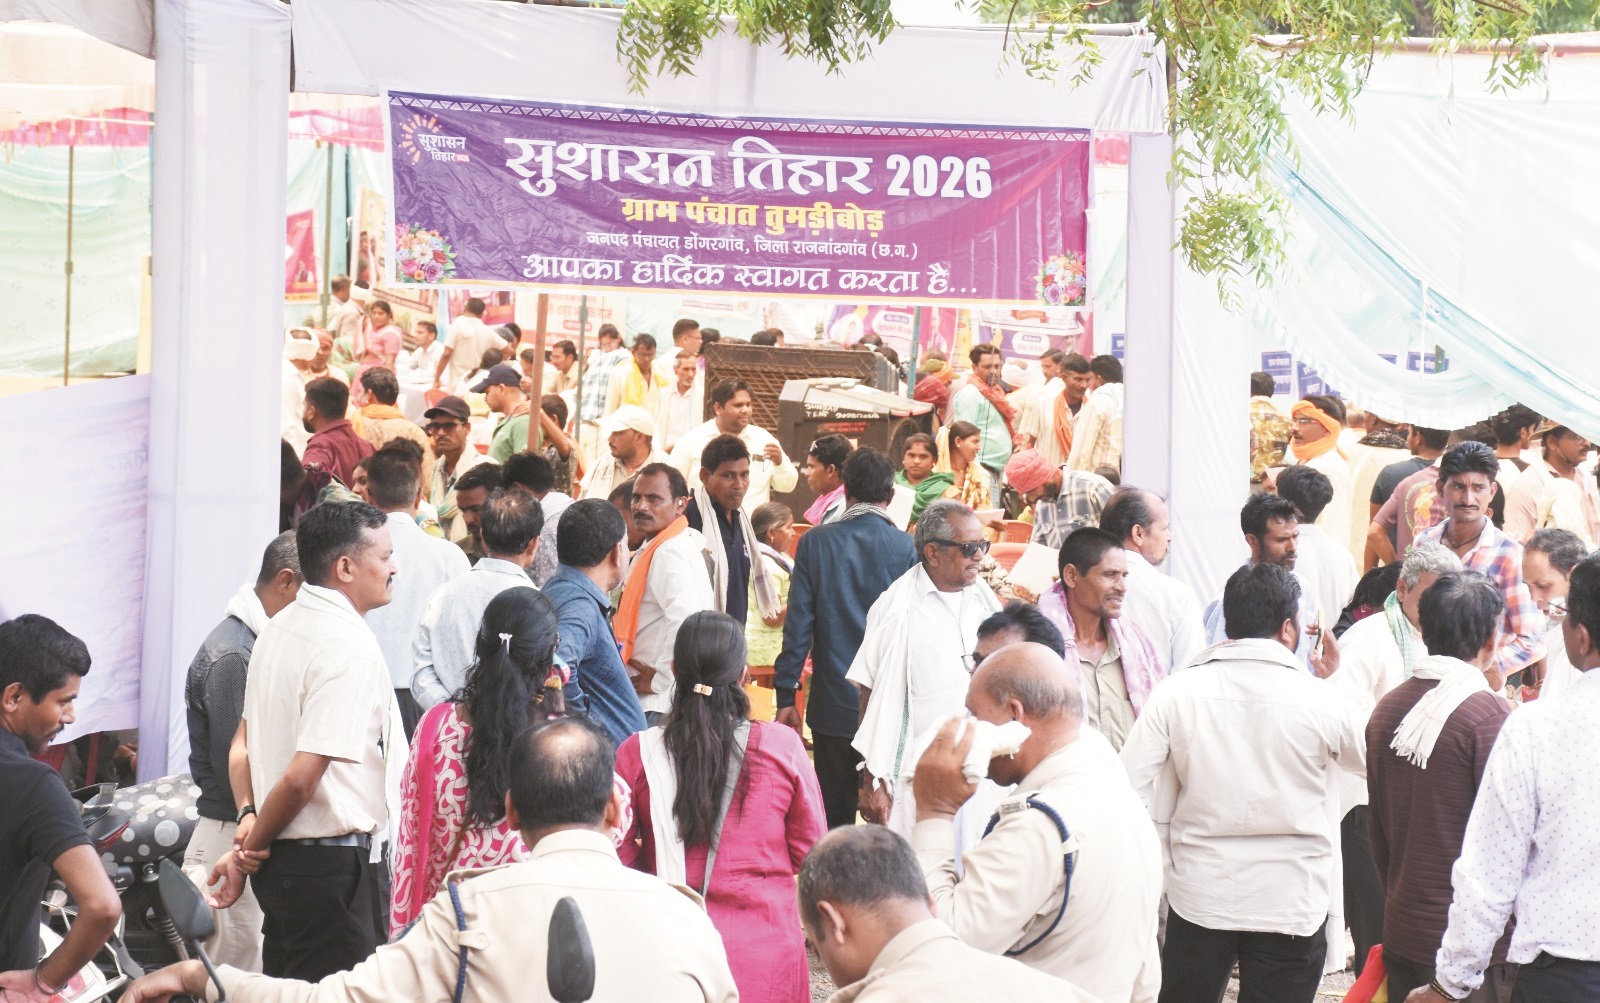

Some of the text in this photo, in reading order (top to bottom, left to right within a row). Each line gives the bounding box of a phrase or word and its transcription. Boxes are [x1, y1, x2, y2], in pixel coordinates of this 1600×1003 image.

[418, 134, 466, 151] सुशासन
[430, 147, 456, 162] तिहार
[504, 136, 992, 199] सुशासन तिहार 2026
[620, 196, 886, 238] ग्राम पंचात तुमड़ीबोड़
[586, 230, 919, 261] जनपद पंचायत डोंगरगांव, जिला राजनांदगांव (छ.ग.)
[521, 253, 624, 281] आपका
[631, 253, 726, 286] हार्दिक
[733, 265, 831, 291] स्वागत
[838, 269, 921, 294] करता
